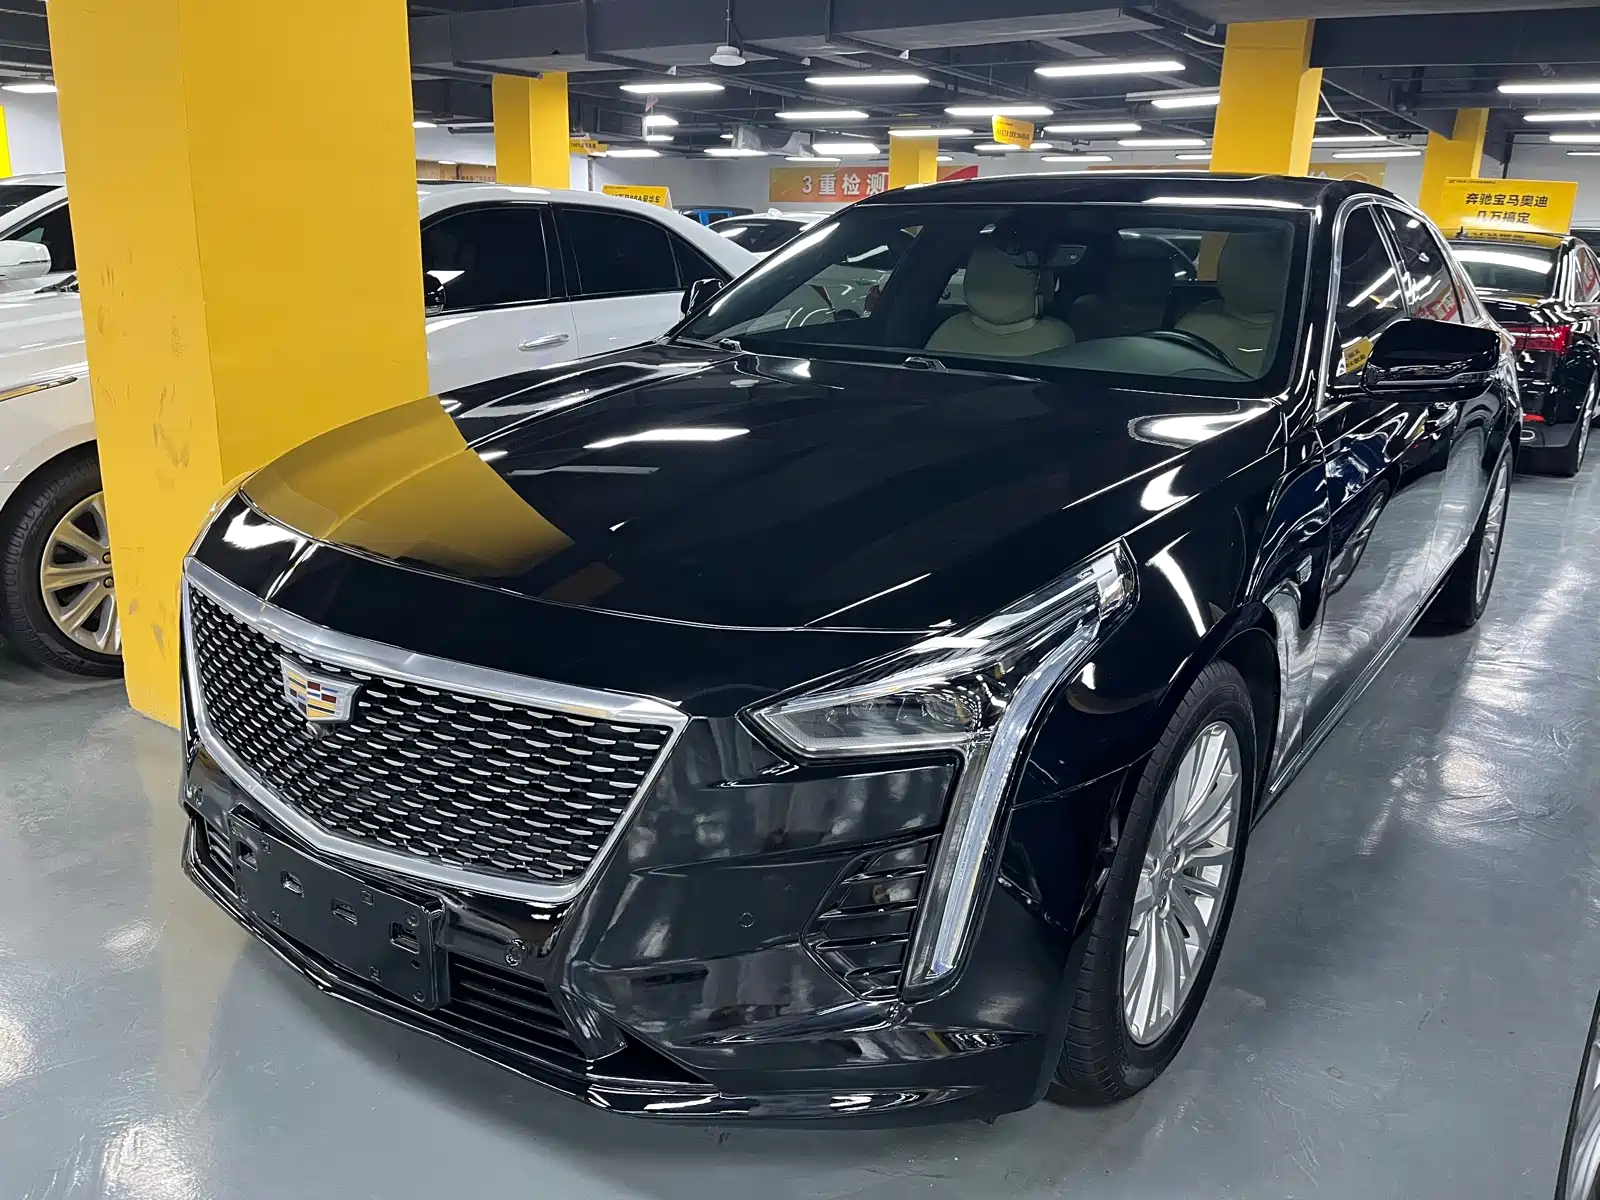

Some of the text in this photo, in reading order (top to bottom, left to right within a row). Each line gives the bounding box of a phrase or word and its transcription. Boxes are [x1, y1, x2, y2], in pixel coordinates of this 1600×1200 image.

[1465, 193, 1549, 208] 奔驰宝马奥迪
[1476, 210, 1531, 224] 几万搞定
